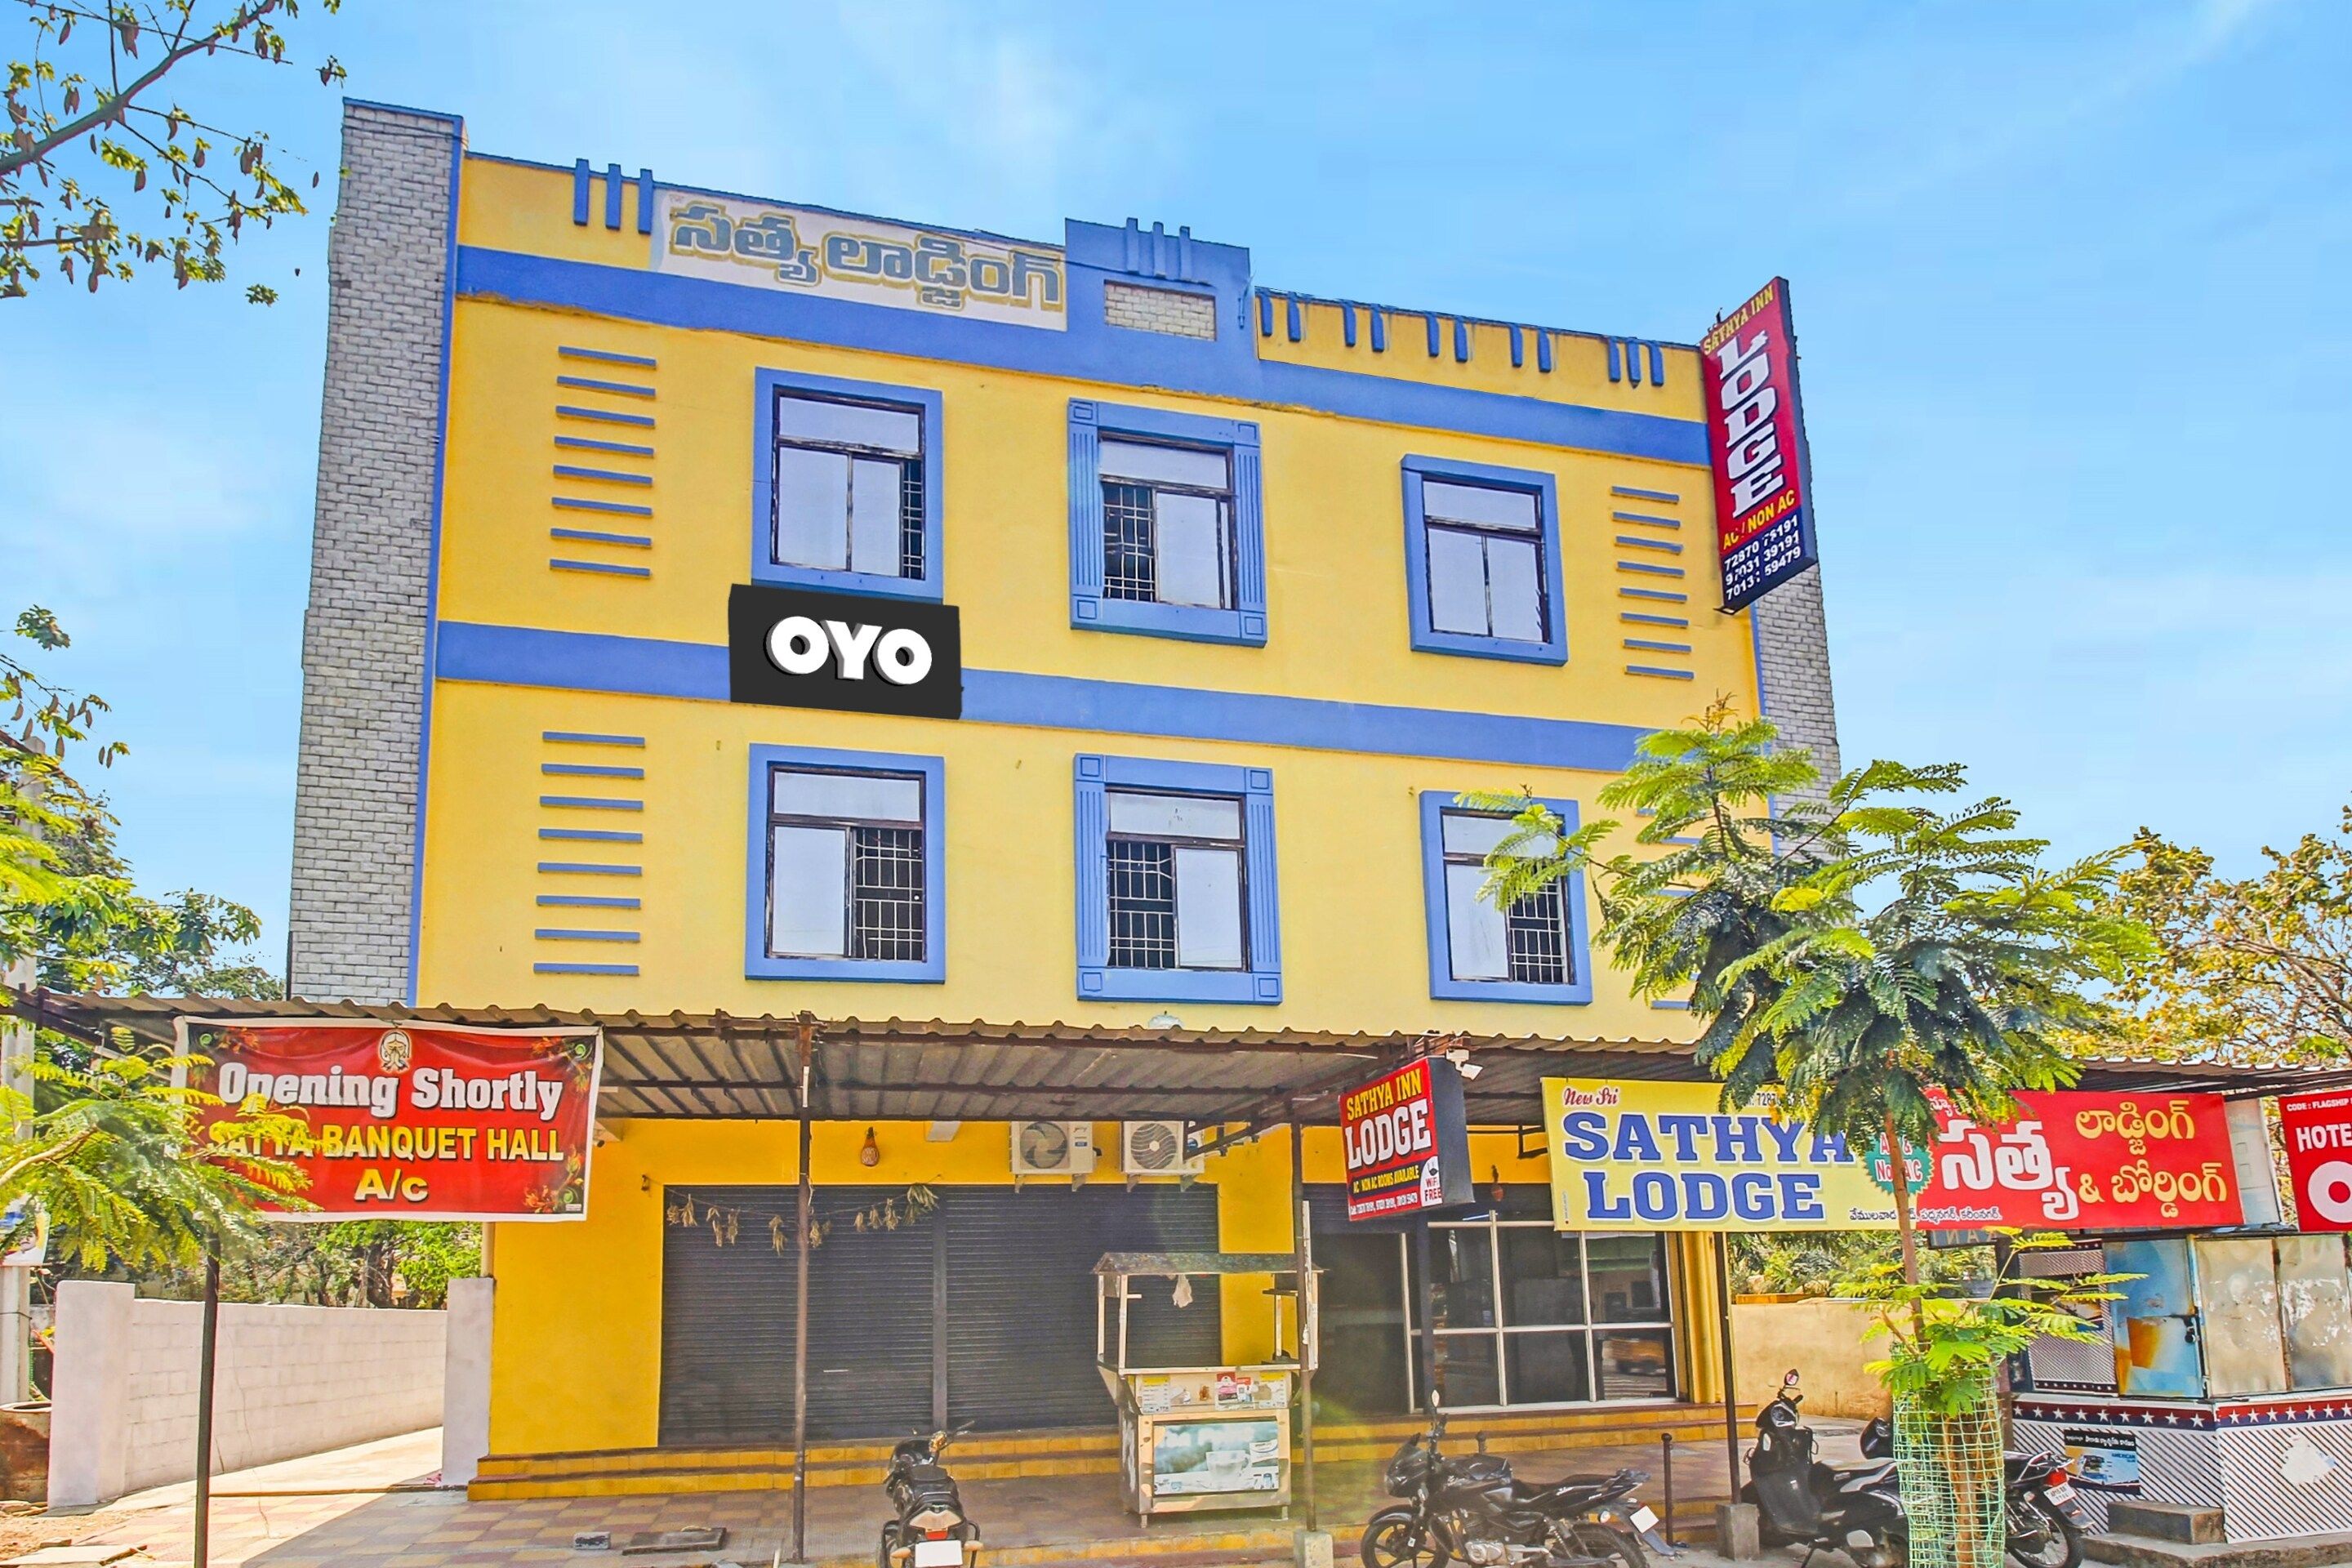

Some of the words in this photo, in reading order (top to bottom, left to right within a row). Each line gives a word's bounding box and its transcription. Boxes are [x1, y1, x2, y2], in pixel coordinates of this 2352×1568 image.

[1704, 308, 1749, 355] SATHYA
[1750, 284, 1774, 315] INN
[1717, 330, 1784, 518] LODGE
[1747, 501, 1775, 533] NON
[1777, 488, 1796, 514] AC
[1724, 540, 1760, 572] 72870
[1763, 530, 1799, 562] 39191
[1765, 546, 1801, 577] 59479
[764, 616, 933, 685] OYO
[218, 1061, 399, 1118] Opening
[410, 1067, 564, 1120] Shortly
[1347, 1080, 1394, 1120] SATHYA
[1396, 1068, 1422, 1101] INN
[1563, 1087, 1593, 1106] New
[1596, 1086, 1619, 1106] Sri
[2287, 1103, 2307, 1111] CODE
[2312, 1098, 2349, 1109] FLAGSHIP
[322, 1124, 477, 1160] BANQUET
[487, 1129, 564, 1161] HALL
[1344, 1098, 1432, 1169] LODGE
[1562, 1111, 1856, 1163] SATHYA
[1424, 1187, 1442, 1202] FREE
[1583, 1170, 1826, 1221] LODGE
[2078, 1174, 2105, 1204] &
